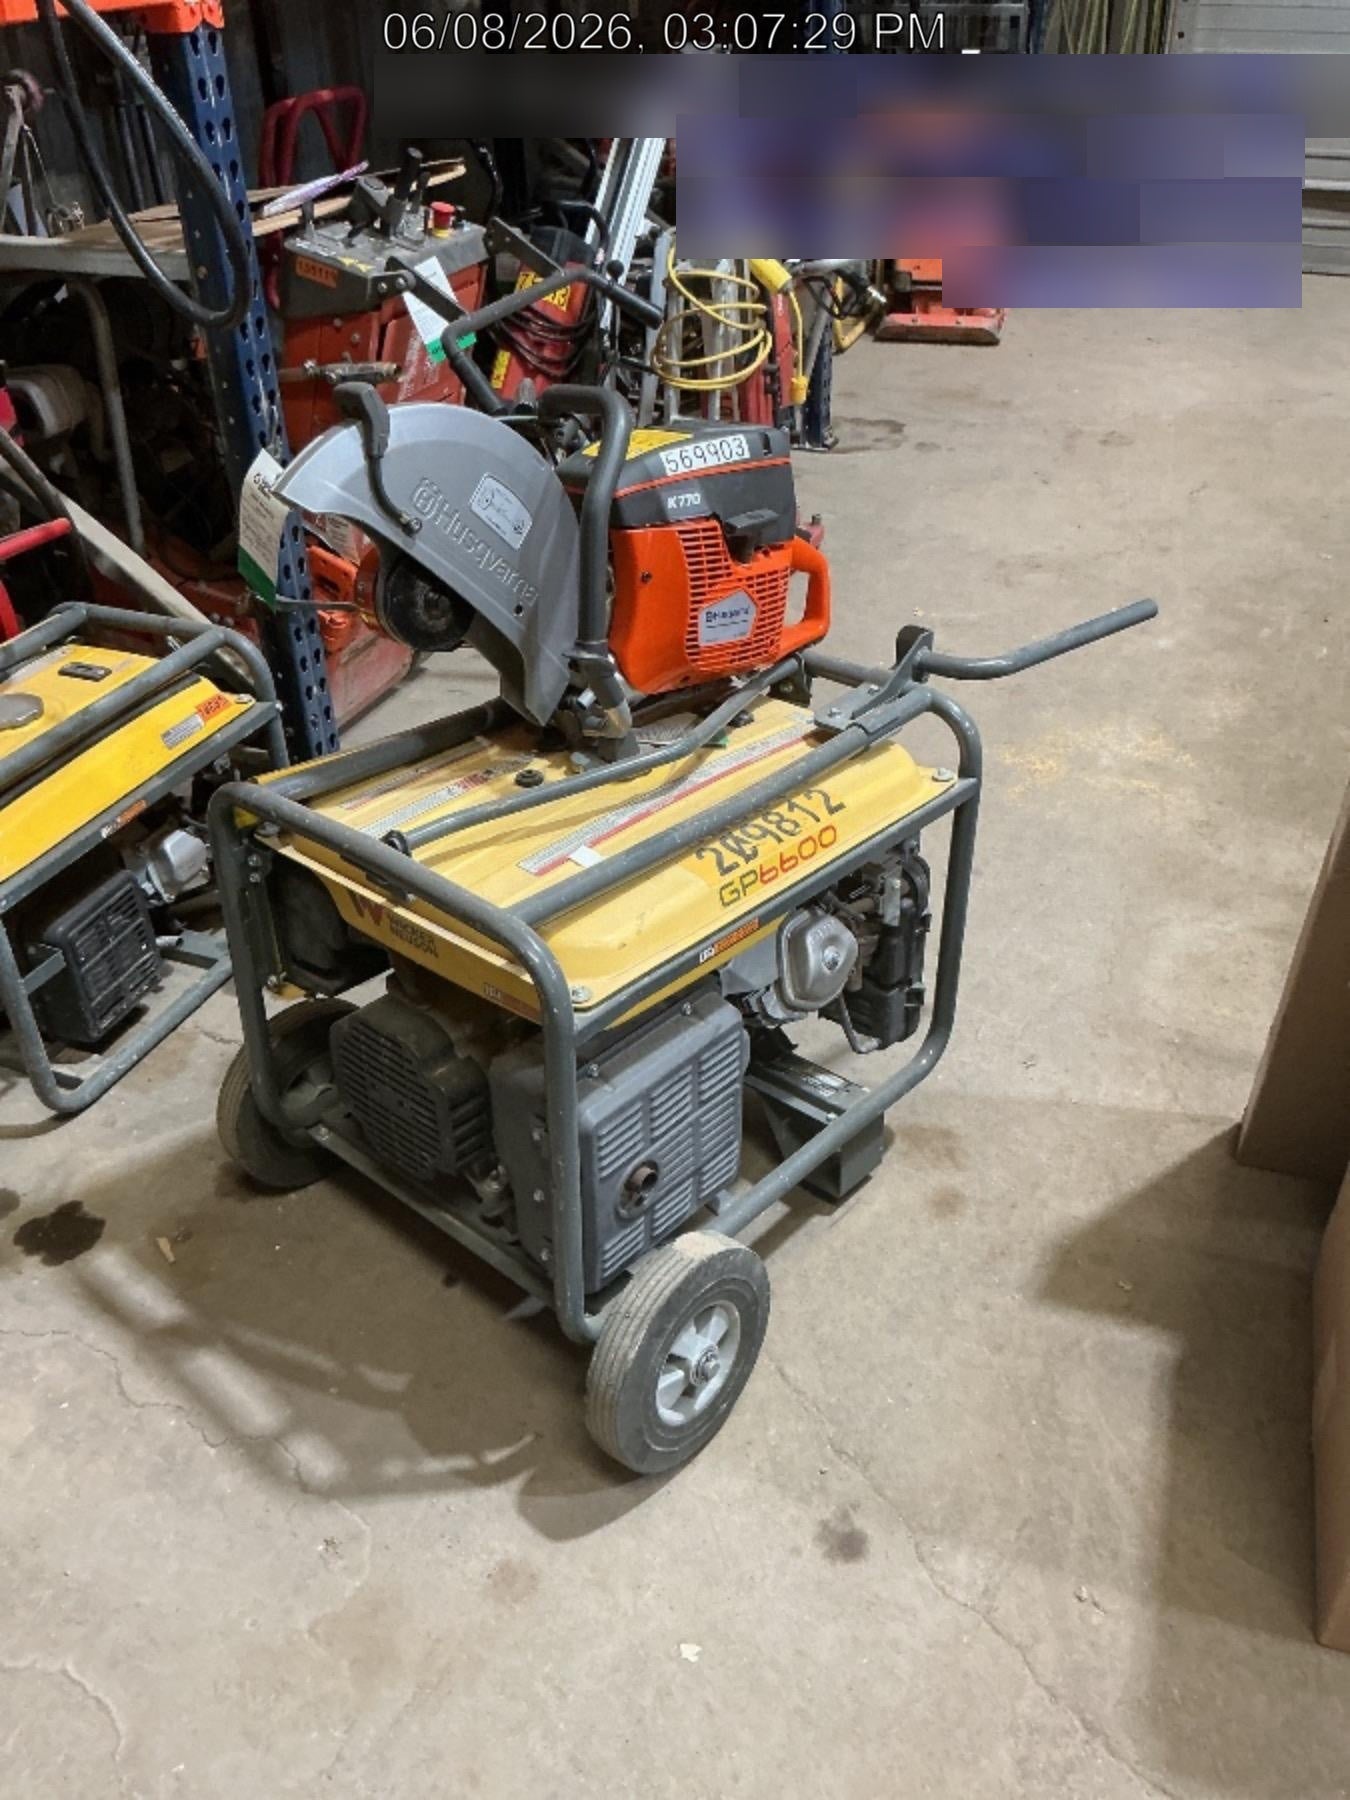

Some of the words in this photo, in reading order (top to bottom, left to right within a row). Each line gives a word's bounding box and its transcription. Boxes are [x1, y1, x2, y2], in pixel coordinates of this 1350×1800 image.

[665, 437, 746, 473] 569903
[433, 501, 539, 608] Husqvarna
[719, 824, 837, 907] GP6600
